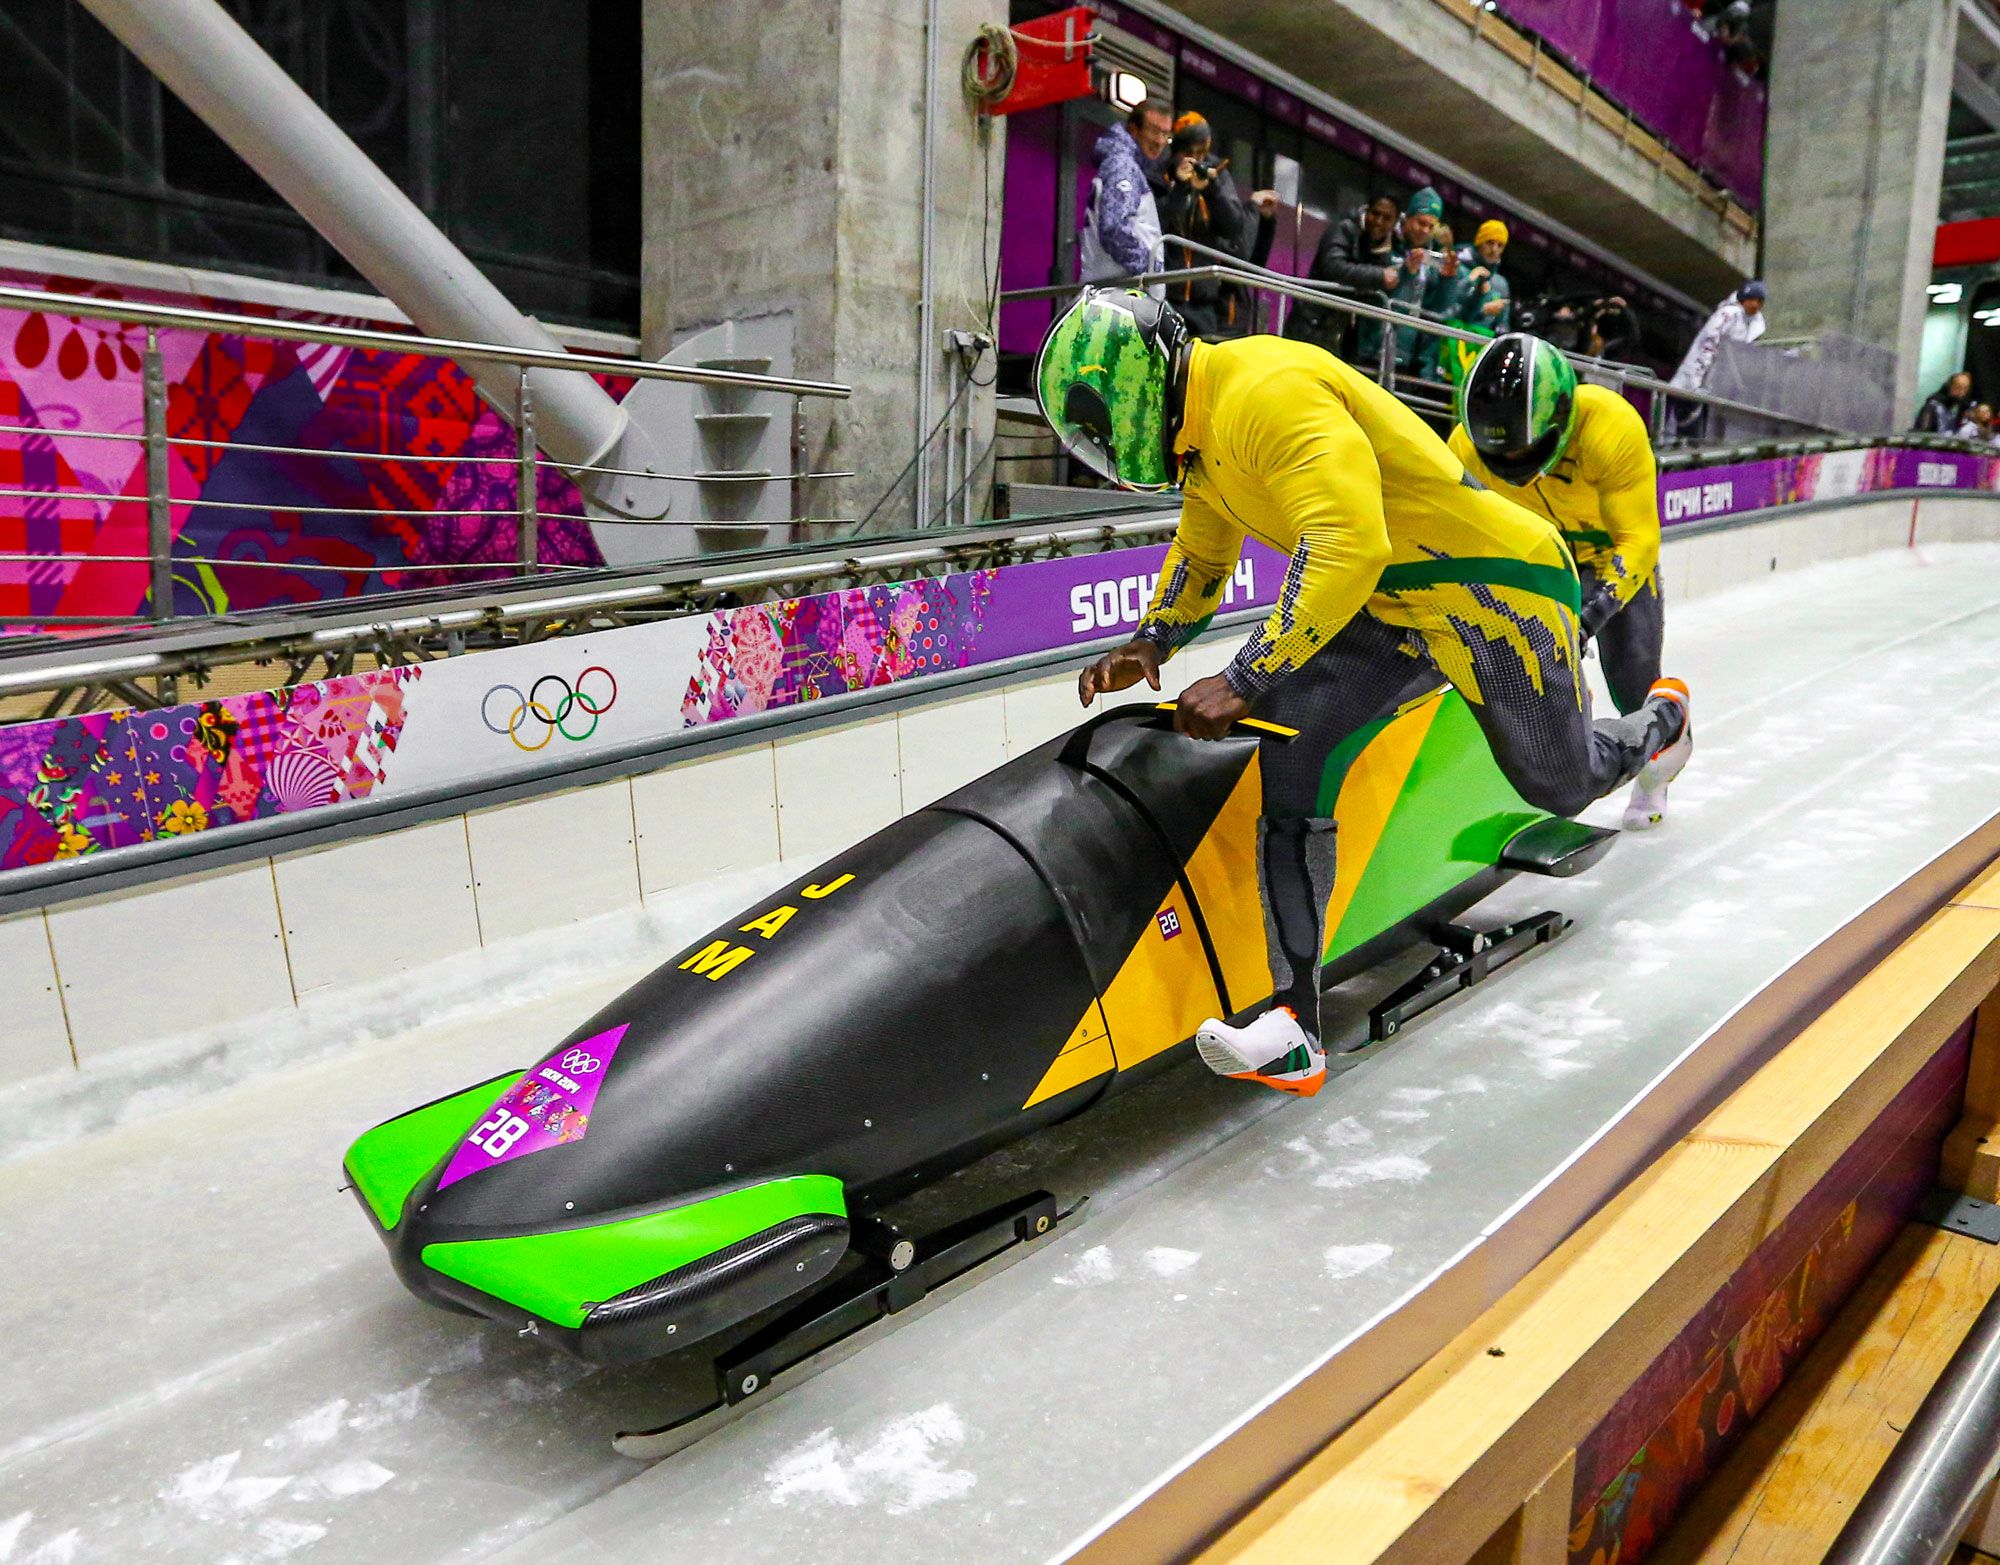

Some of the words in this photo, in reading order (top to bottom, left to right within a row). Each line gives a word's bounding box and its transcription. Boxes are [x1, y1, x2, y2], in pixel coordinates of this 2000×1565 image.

[1702, 481, 1733, 514] 2014
[1070, 572, 1160, 633] SOCH
[1158, 911, 1180, 935] 28
[556, 1076, 582, 1095] 2014
[467, 1107, 530, 1158] 28
